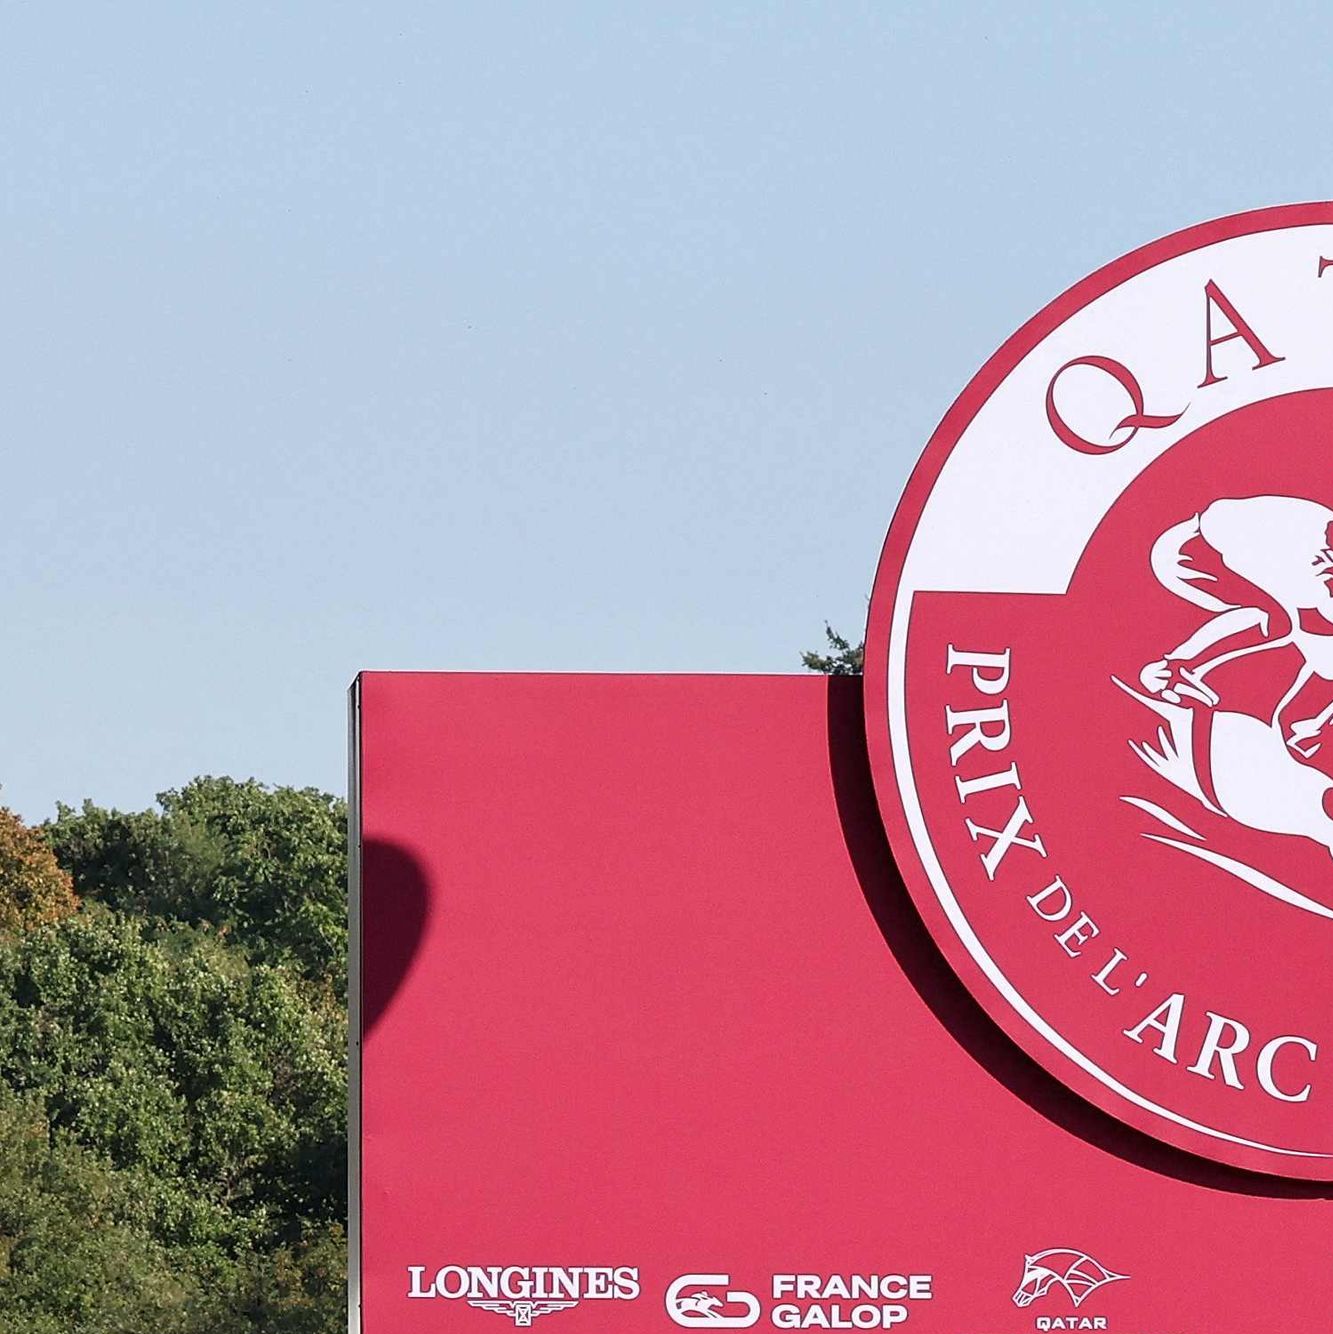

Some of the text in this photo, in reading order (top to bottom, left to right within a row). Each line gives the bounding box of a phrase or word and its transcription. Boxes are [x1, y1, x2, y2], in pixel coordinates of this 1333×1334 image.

[943, 644, 1046, 882] PRIX
[1026, 873, 1099, 956] DE
[408, 1266, 640, 1301] LONGINES
[772, 1274, 933, 1300] FRANCE
[771, 1304, 908, 1329] GALOP
[1036, 1316, 1107, 1332] QATAR
